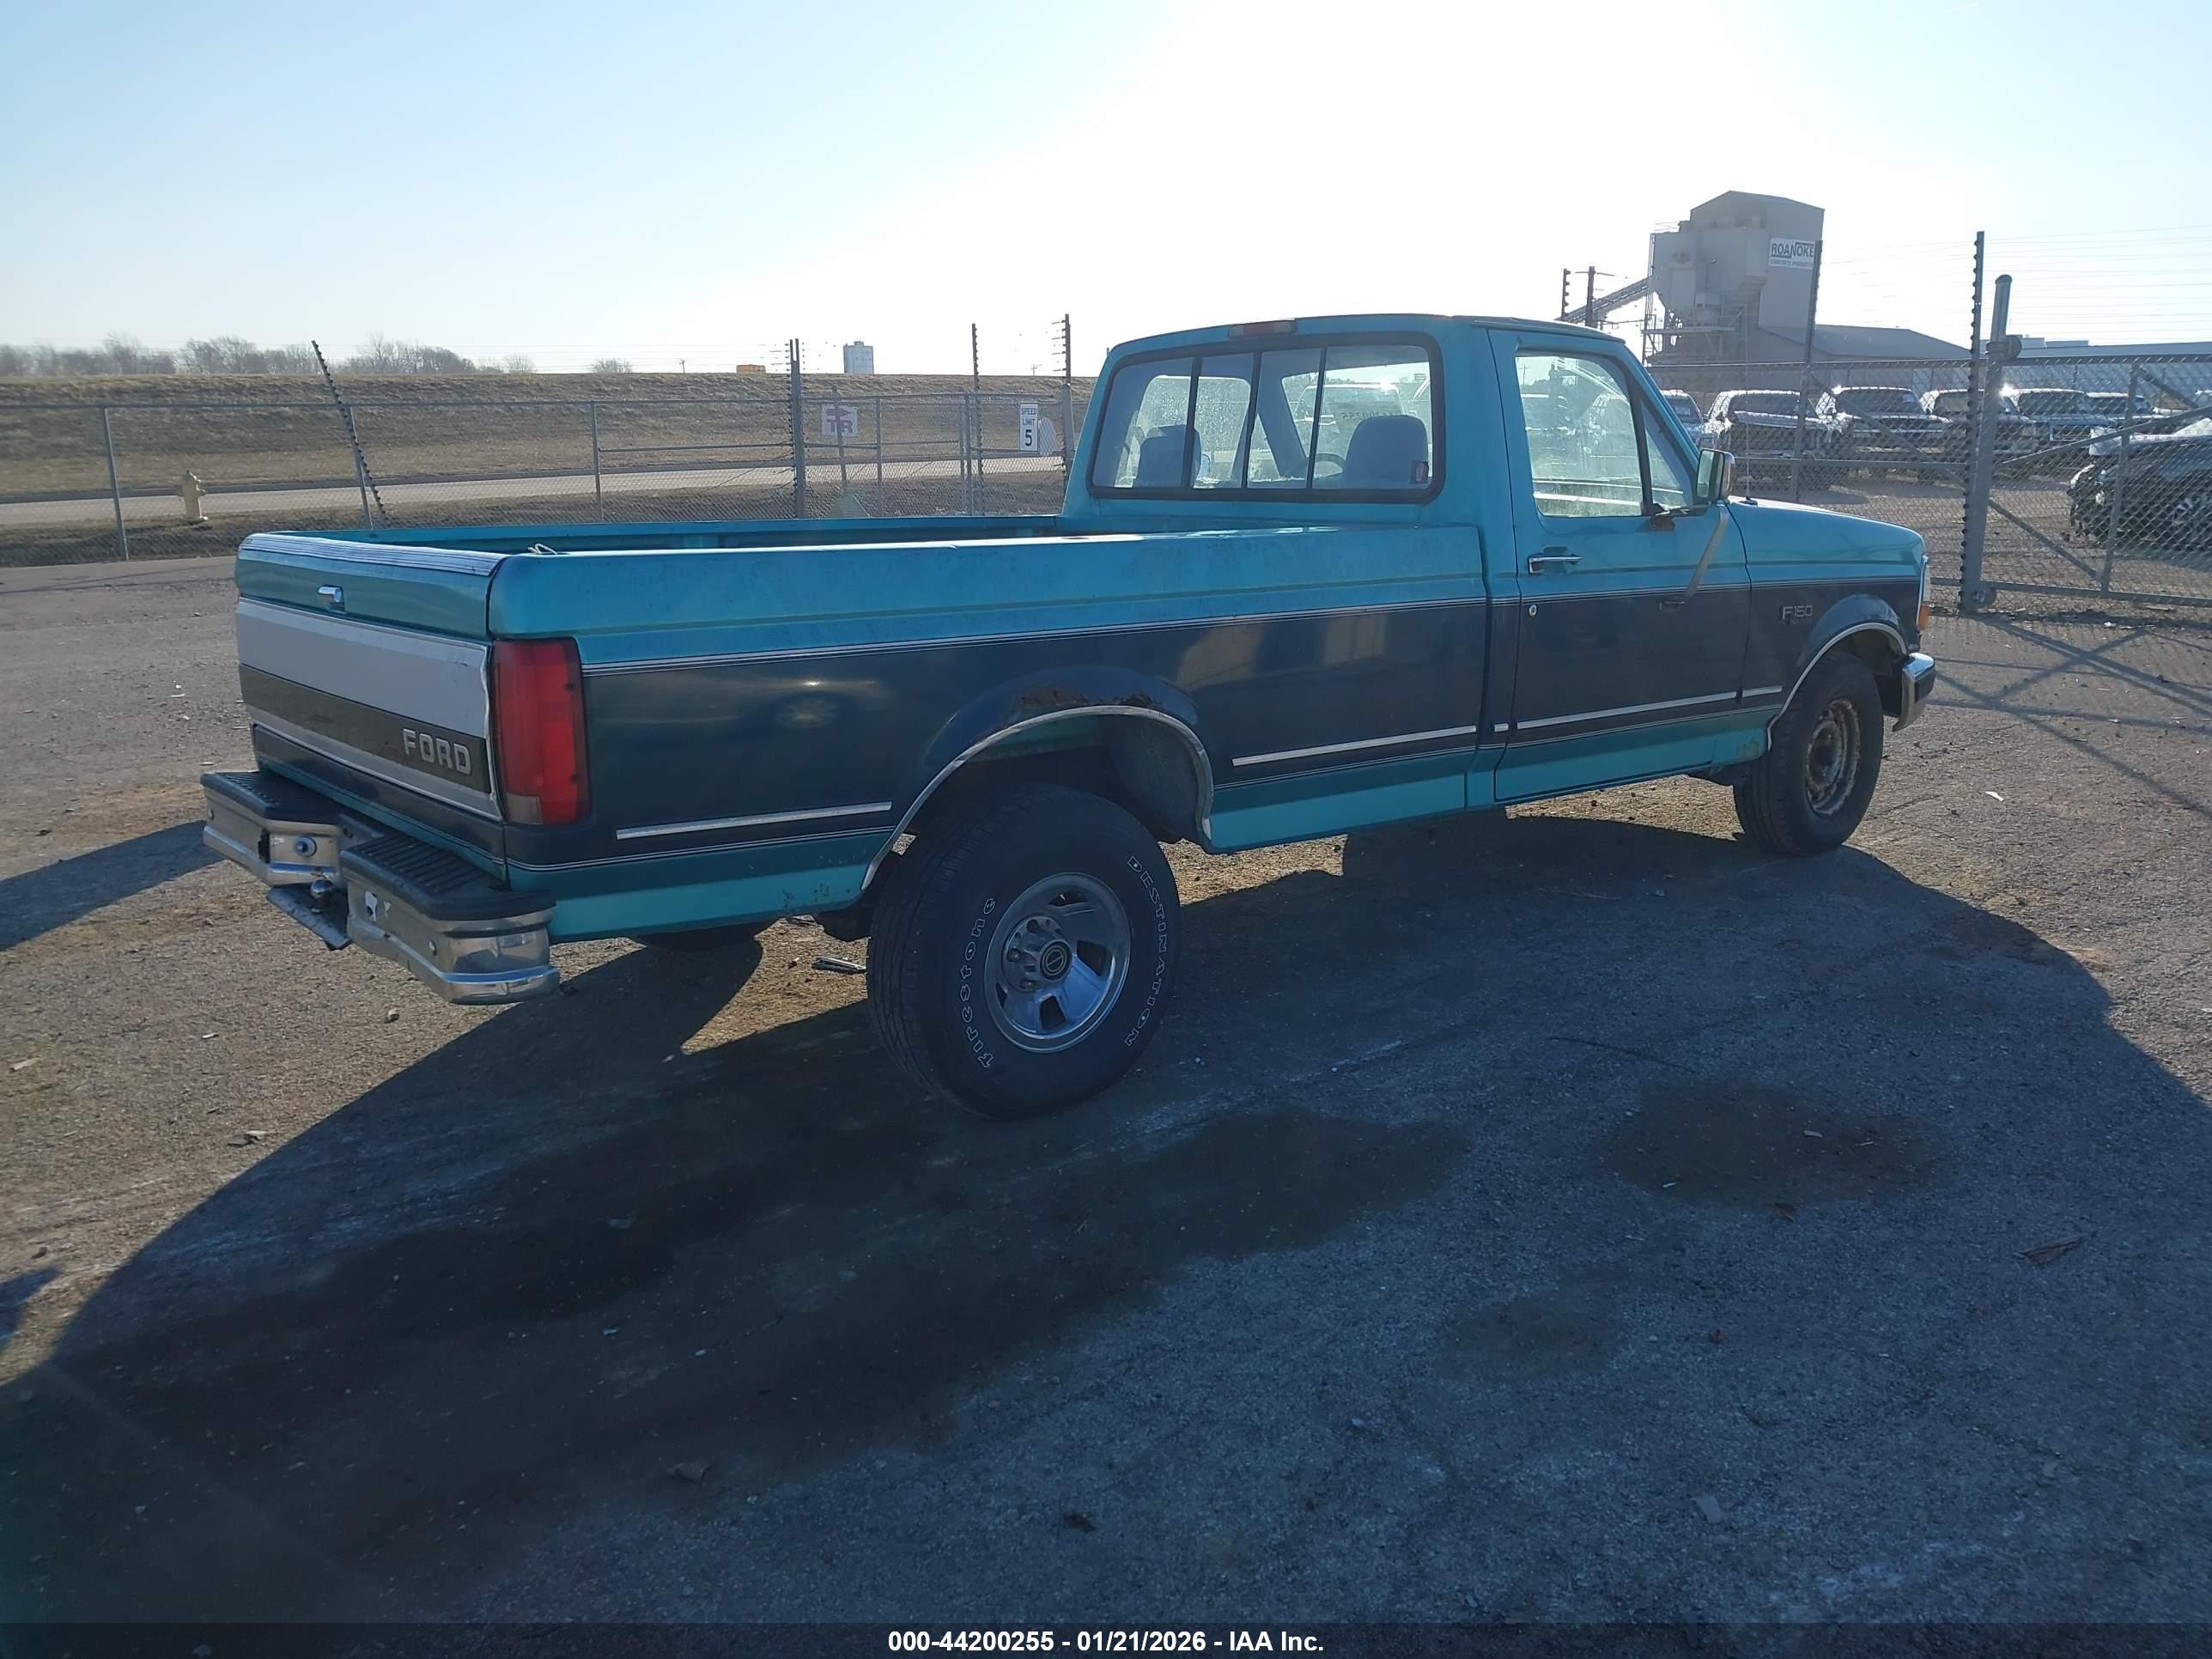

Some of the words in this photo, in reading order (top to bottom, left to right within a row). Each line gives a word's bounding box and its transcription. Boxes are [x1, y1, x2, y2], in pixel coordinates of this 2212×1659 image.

[1771, 241, 1814, 258] ROANOKE
[1021, 407, 1037, 416] SPEED
[1024, 428, 1033, 447] 5
[402, 728, 471, 775] FORD
[1127, 855, 1169, 1047] DESTINATION
[959, 897, 996, 1067] Firestone
